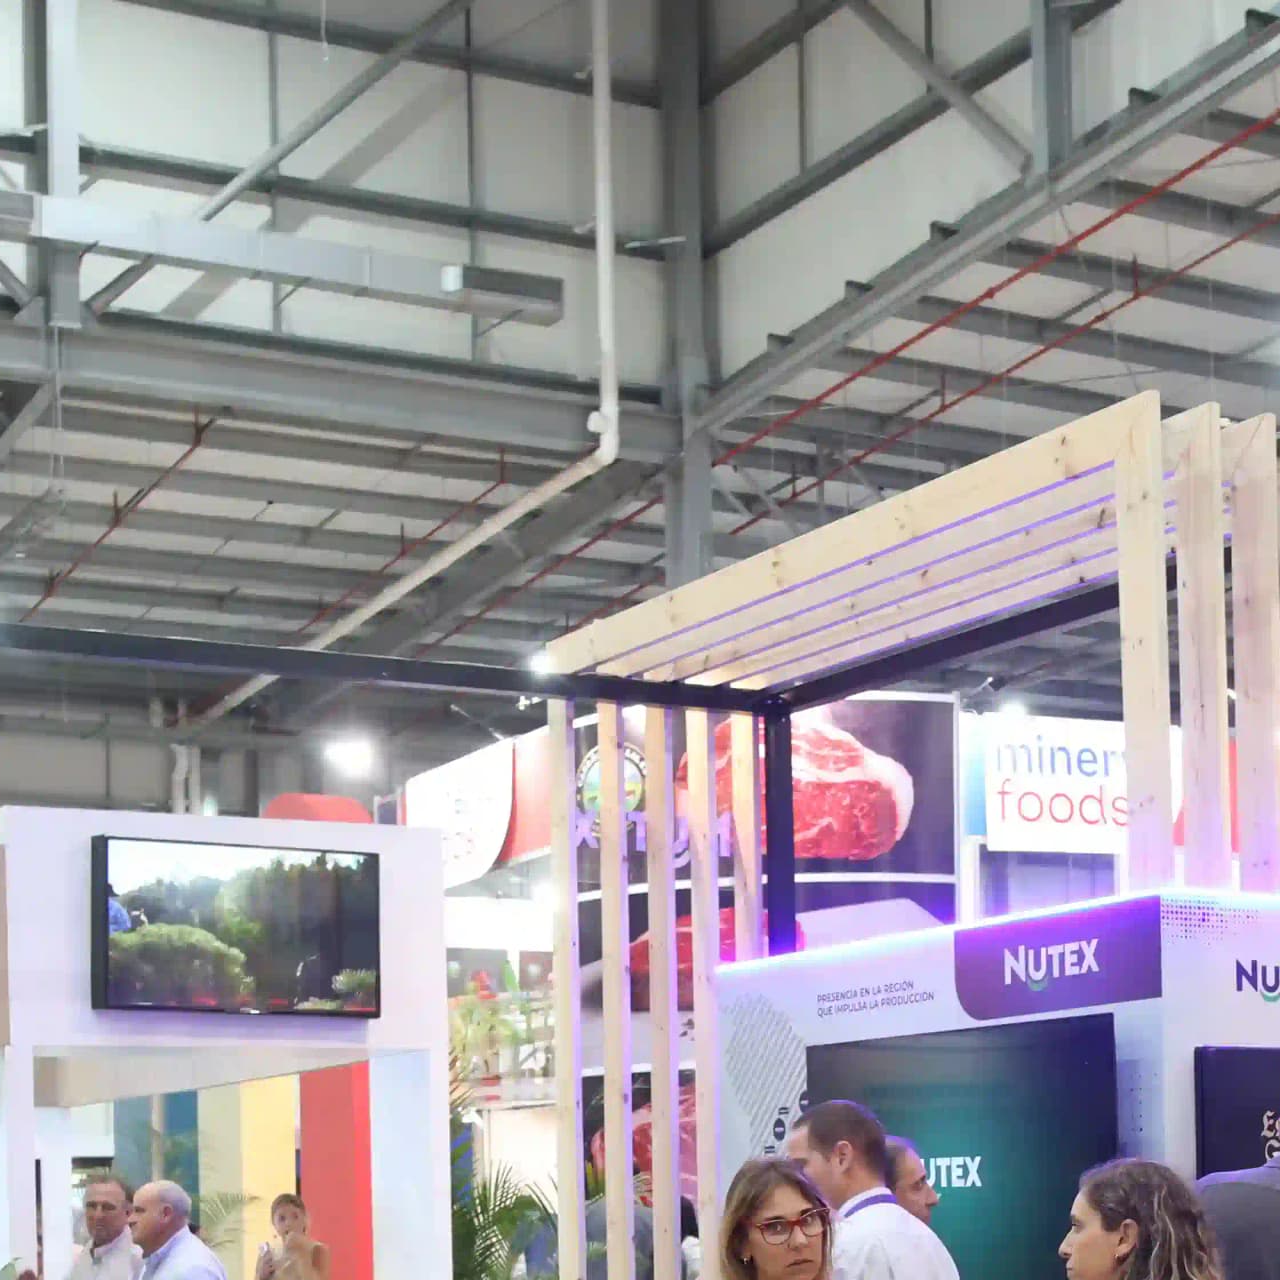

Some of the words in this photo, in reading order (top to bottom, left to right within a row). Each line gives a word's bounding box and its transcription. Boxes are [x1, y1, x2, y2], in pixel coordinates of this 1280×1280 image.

[996, 734, 1117, 777] miner
[997, 778, 1129, 826] foods
[1004, 939, 1100, 985] NUTEX
[920, 1156, 982, 1188] UTEX
